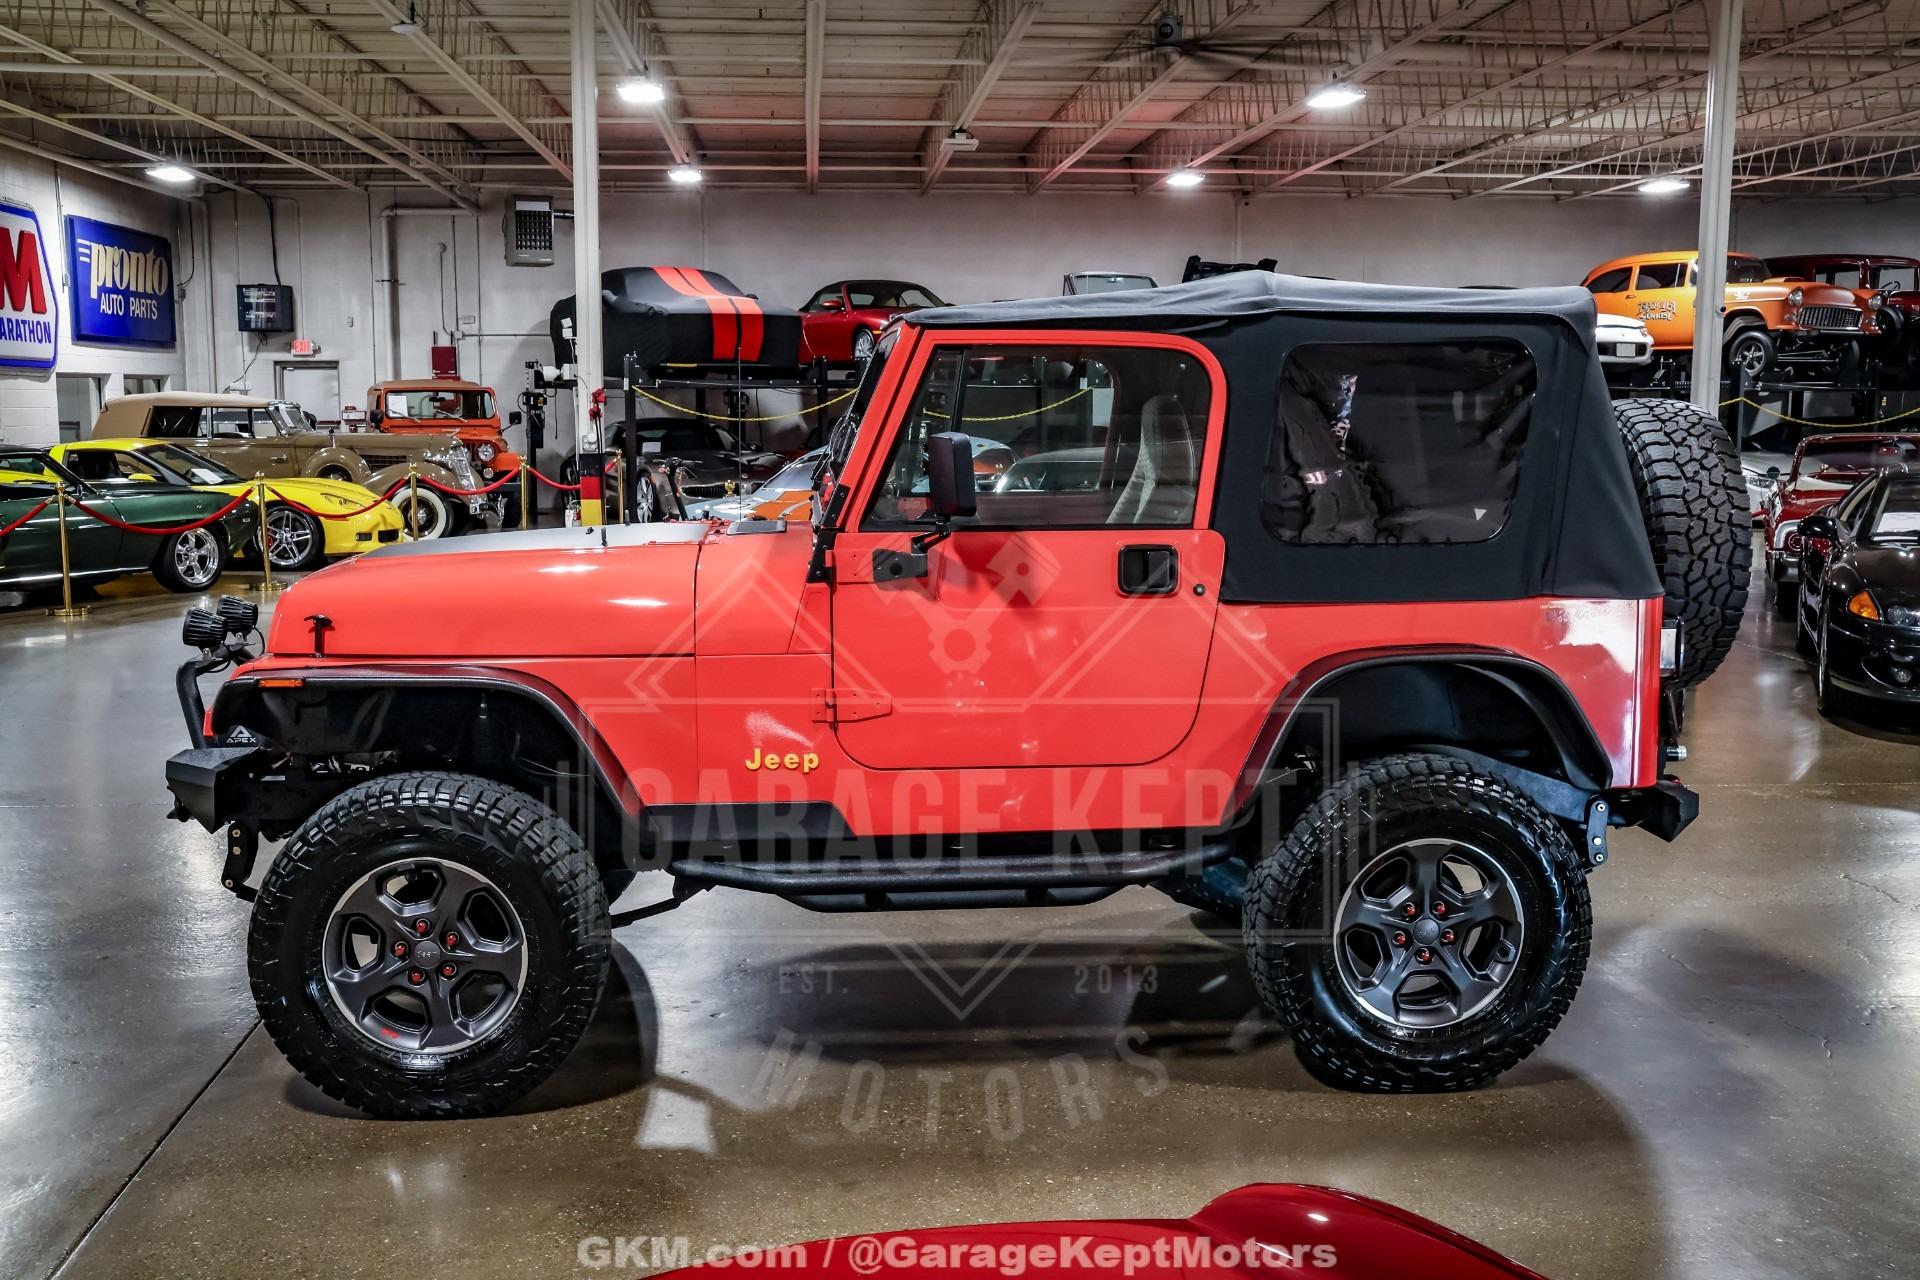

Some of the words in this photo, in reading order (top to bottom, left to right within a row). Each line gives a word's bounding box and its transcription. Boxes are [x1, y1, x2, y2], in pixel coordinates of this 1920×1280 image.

[89, 241, 169, 299] pronto
[100, 293, 124, 316] AUTO
[130, 297, 158, 320] PARTS
[294, 340, 310, 353] EXIT
[745, 748, 819, 773] Jeep
